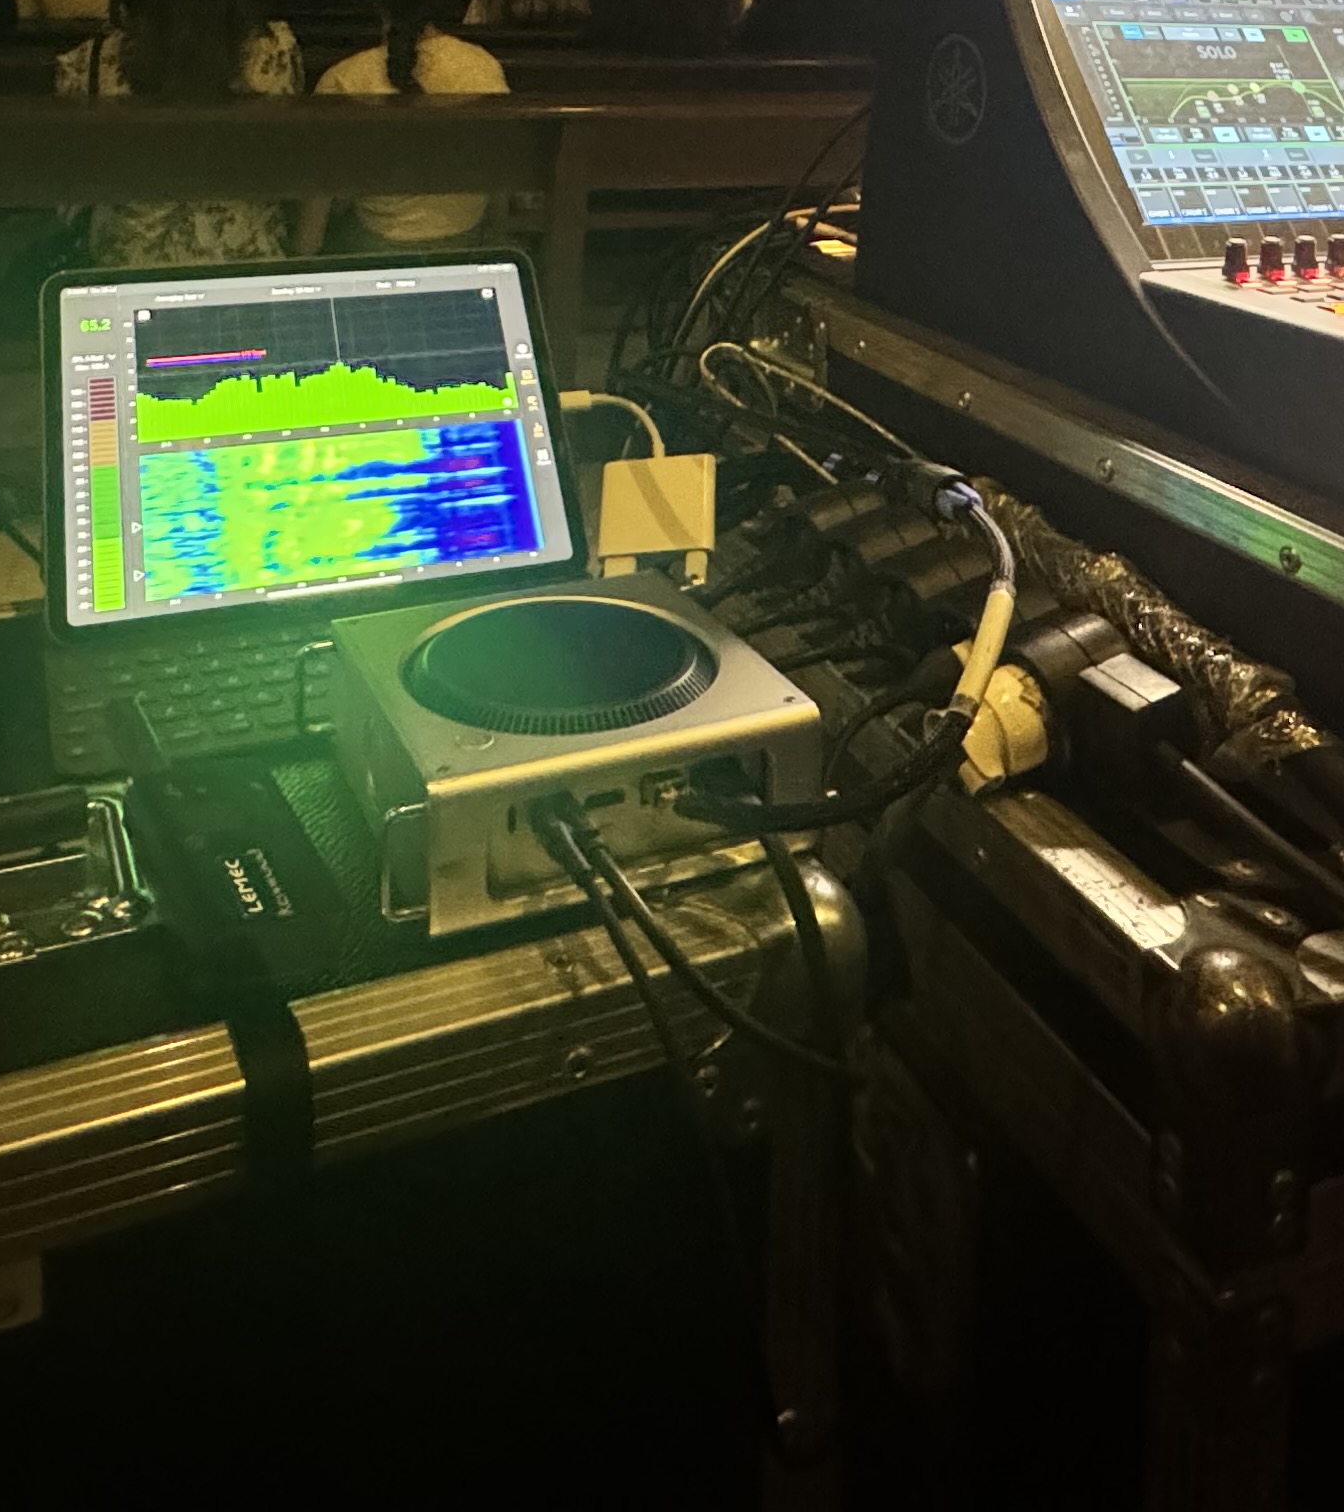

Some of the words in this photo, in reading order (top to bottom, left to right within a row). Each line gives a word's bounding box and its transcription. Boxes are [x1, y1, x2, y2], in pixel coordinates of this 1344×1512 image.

[1196, 45, 1238, 60] SOLO
[79, 318, 112, 333] 65.2
[224, 858, 264, 912] LEMEC
